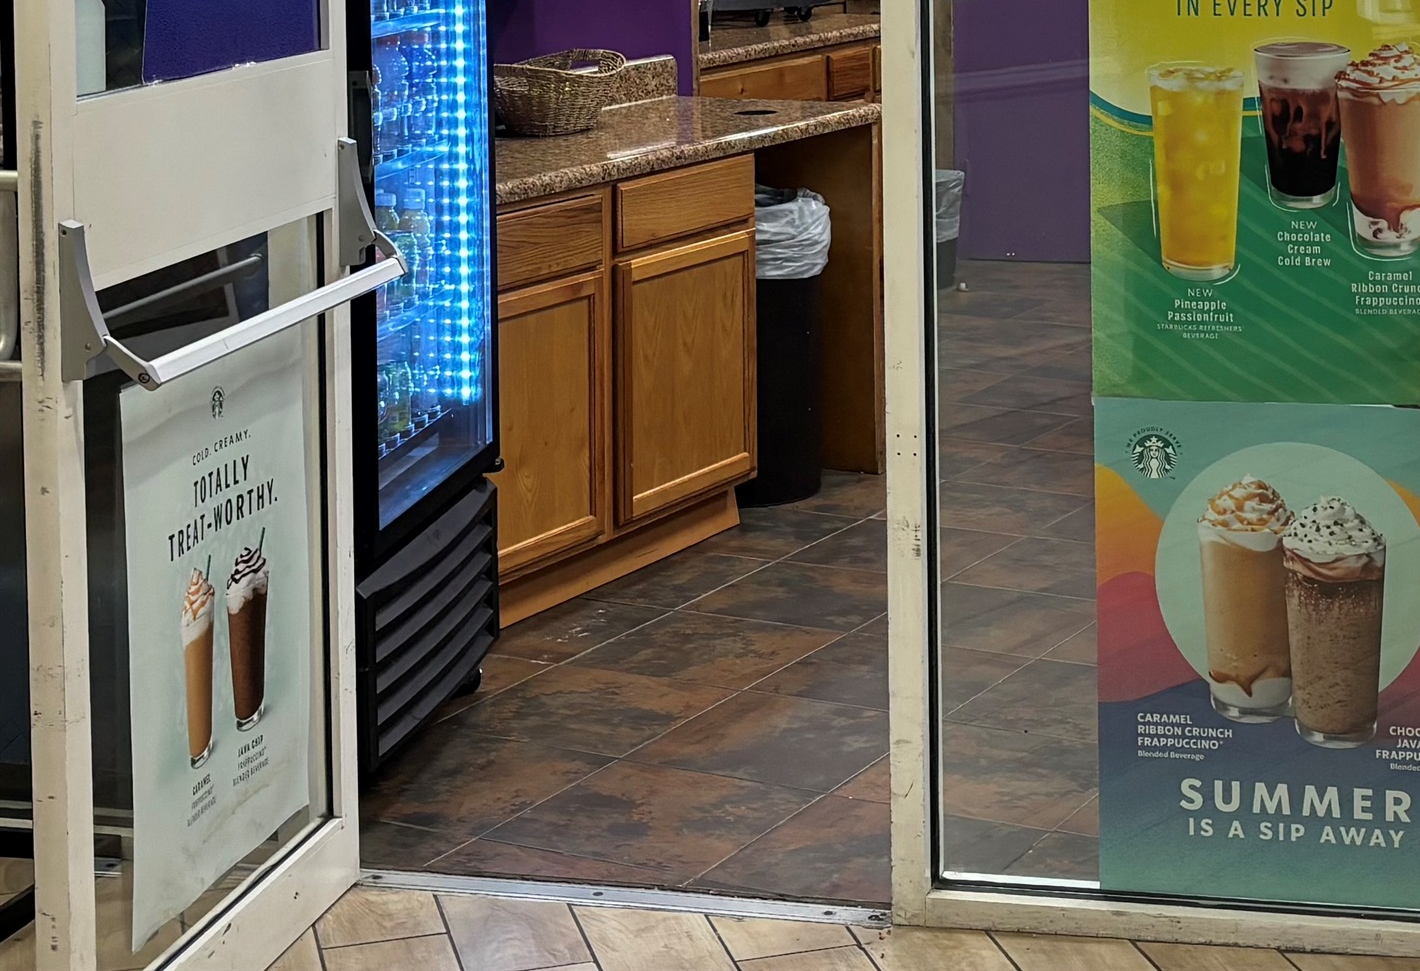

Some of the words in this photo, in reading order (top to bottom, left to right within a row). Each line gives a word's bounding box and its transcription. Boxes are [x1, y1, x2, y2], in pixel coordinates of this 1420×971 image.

[1291, 221, 1317, 229] NEW
[1277, 231, 1331, 242] Chocolate
[1287, 244, 1321, 254] Cream
[1277, 255, 1301, 266] Cold
[1305, 256, 1331, 266] Brew
[1368, 270, 1412, 281] Caramel
[1187, 288, 1213, 297] NEW
[1351, 283, 1388, 293] Ribbon
[1174, 299, 1227, 311] Pineapple
[1167, 311, 1234, 323] Passionfruit
[1157, 323, 1197, 331] STARBUCKS
[1182, 332, 1219, 340] BEVERAGE
[192, 448, 211, 466] COLD.
[214, 429, 251, 453] CREAMY.
[193, 454, 250, 508] TOTALLY
[168, 478, 278, 562] TREAT-WORTHY.
[1137, 713, 1193, 725] CARAMEL
[1137, 725, 1182, 735] RIBBON
[1184, 727, 1233, 738] CRUNCH
[1137, 750, 1169, 758] Blended
[1170, 751, 1205, 761] Beverage
[1179, 778, 1412, 823] SUMMER
[1189, 817, 1214, 837] IS
[1227, 820, 1245, 839] A
[1259, 822, 1306, 842] SIP
[1319, 825, 1404, 848] AWAY
